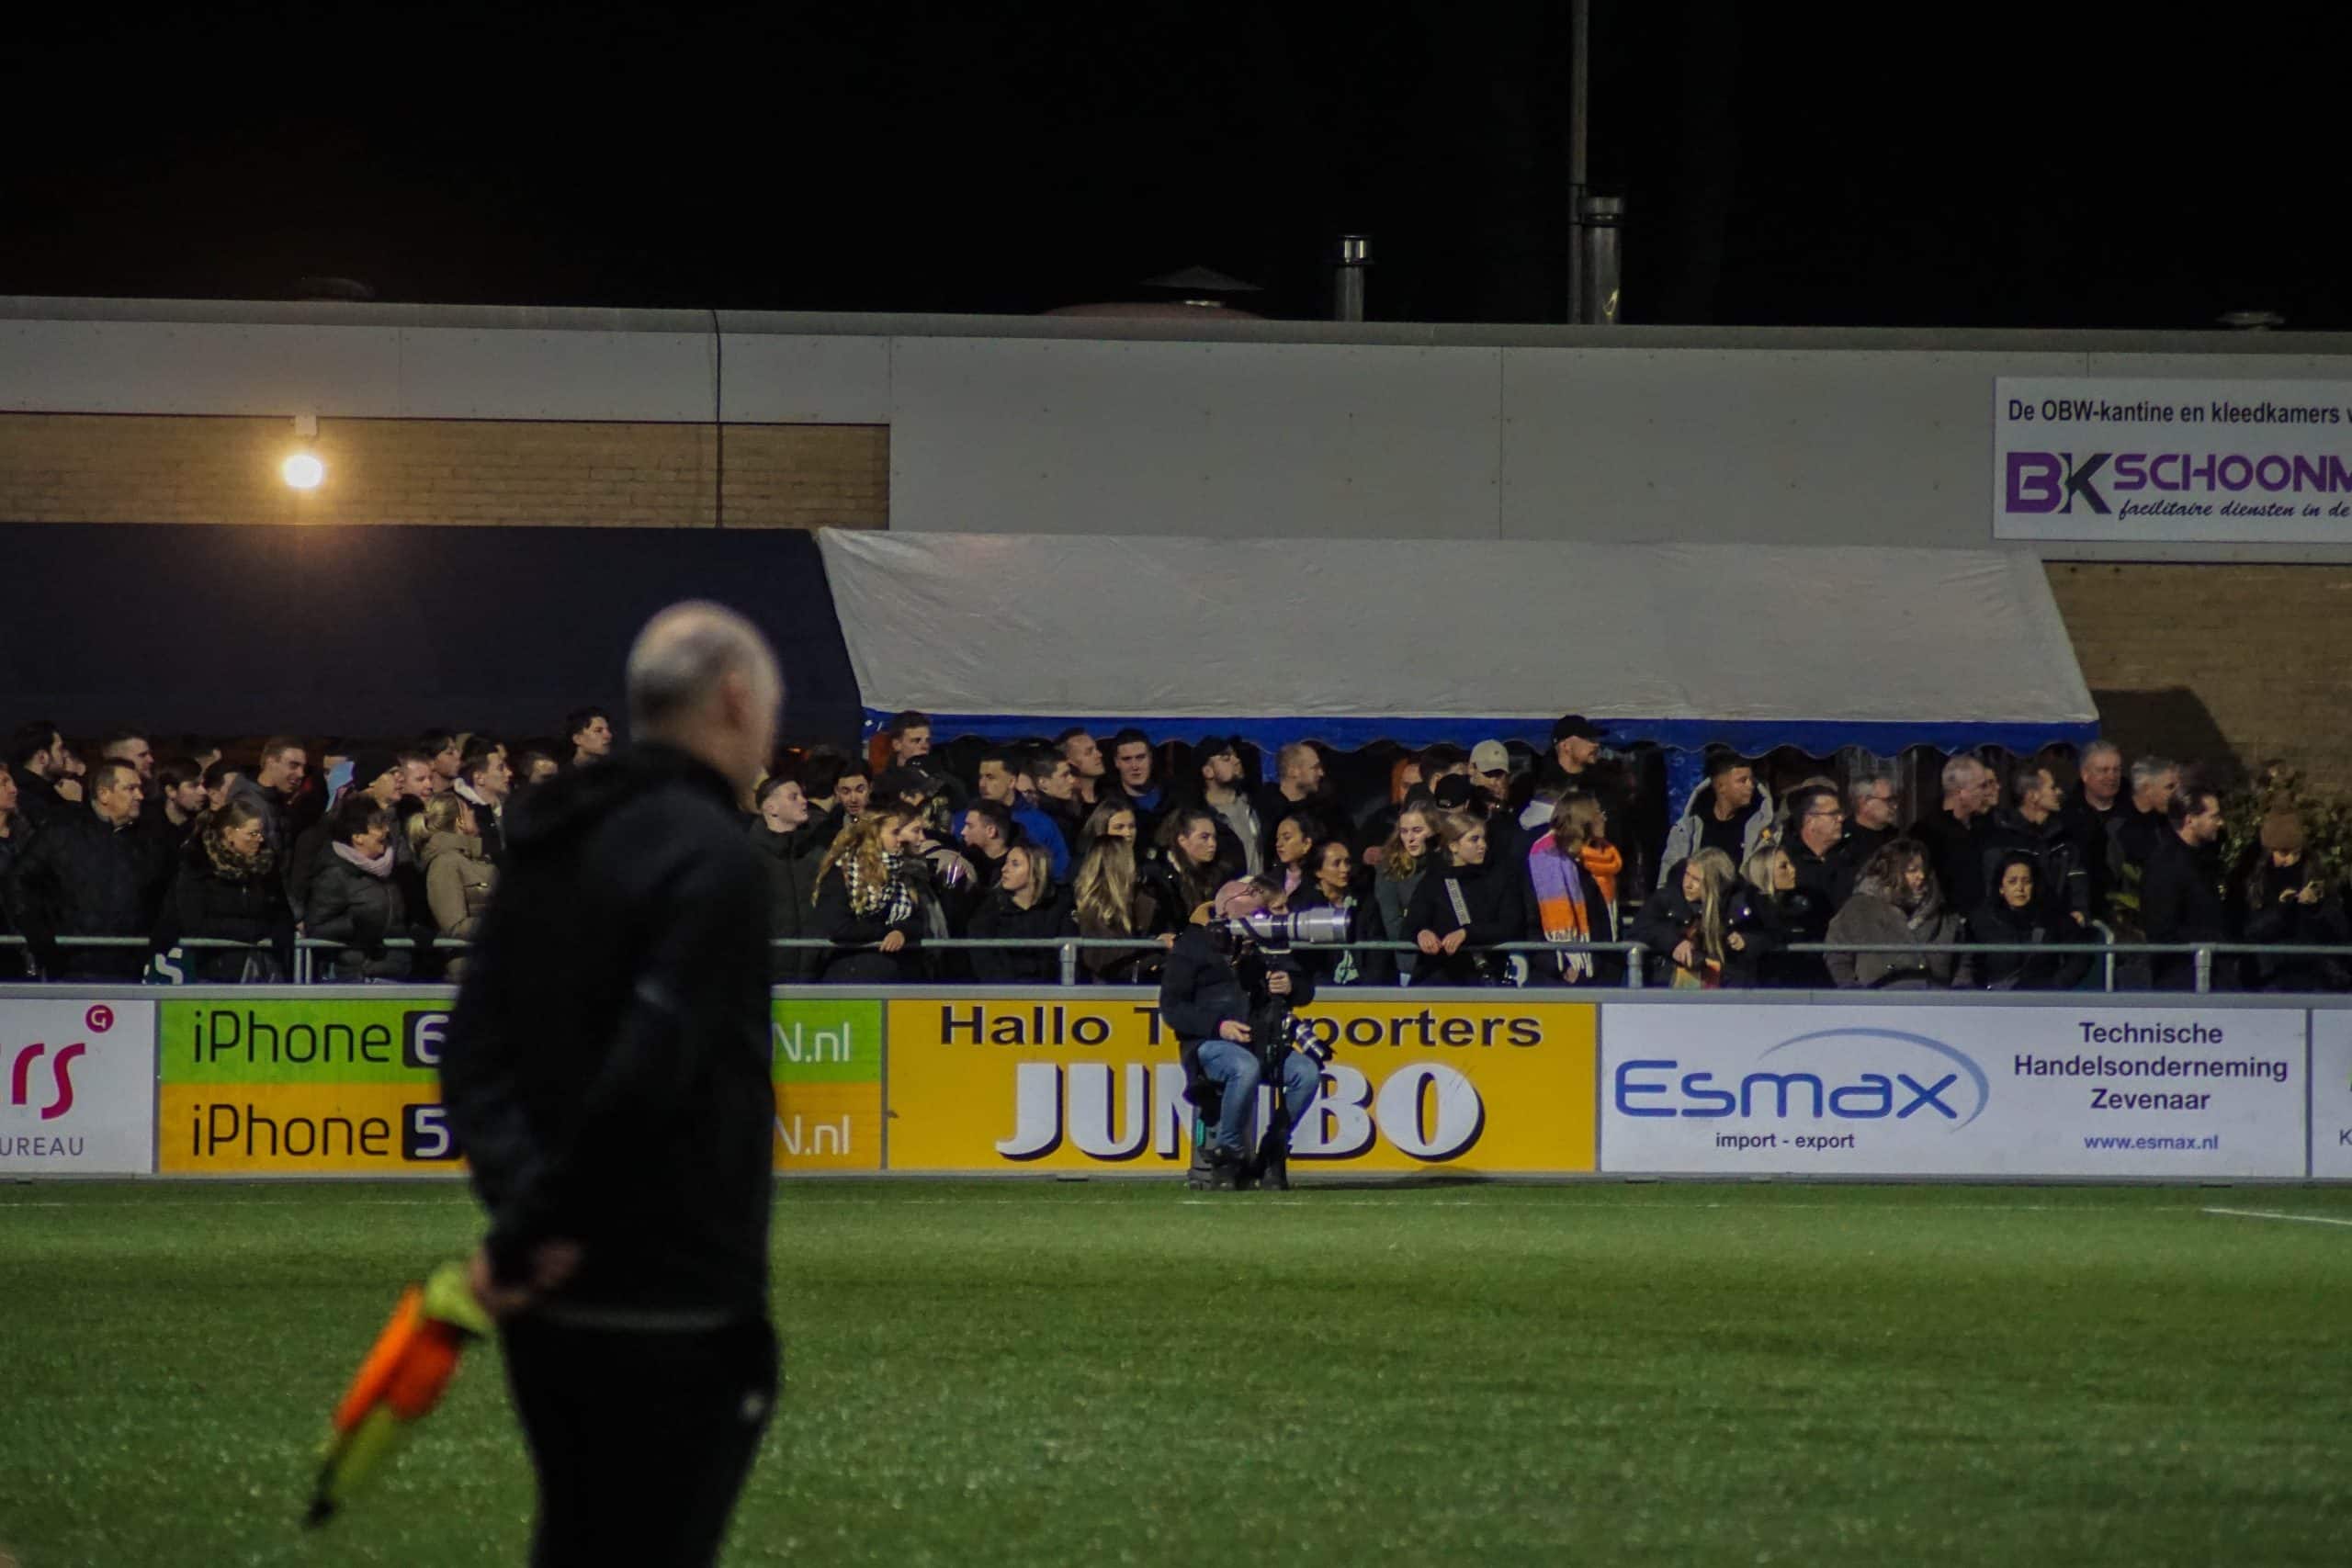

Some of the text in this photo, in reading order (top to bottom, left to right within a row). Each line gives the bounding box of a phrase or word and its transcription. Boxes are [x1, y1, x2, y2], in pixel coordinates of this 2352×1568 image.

[2009, 400, 2034, 421] De
[2041, 400, 2174, 423] OBW-kantine
[2180, 406, 2204, 423] en
[2211, 401, 2340, 424] kleedkamers
[2119, 499, 2350, 521] facilitaire diensten in de
[195, 1010, 391, 1064] iPhone
[941, 1006, 1110, 1046] Hallo
[2078, 1021, 2222, 1044] Technische
[0, 1043, 85, 1120] rs
[2015, 1055, 2288, 1083] Handelsonderneming
[1616, 1059, 1958, 1119] Esmax
[2091, 1088, 2211, 1111] Zevenaar
[193, 1104, 450, 1157] iPhone 5
[1716, 1133, 1776, 1151] import
[1794, 1134, 1855, 1151] export
[2084, 1134, 2219, 1150] www.esmax.nl
